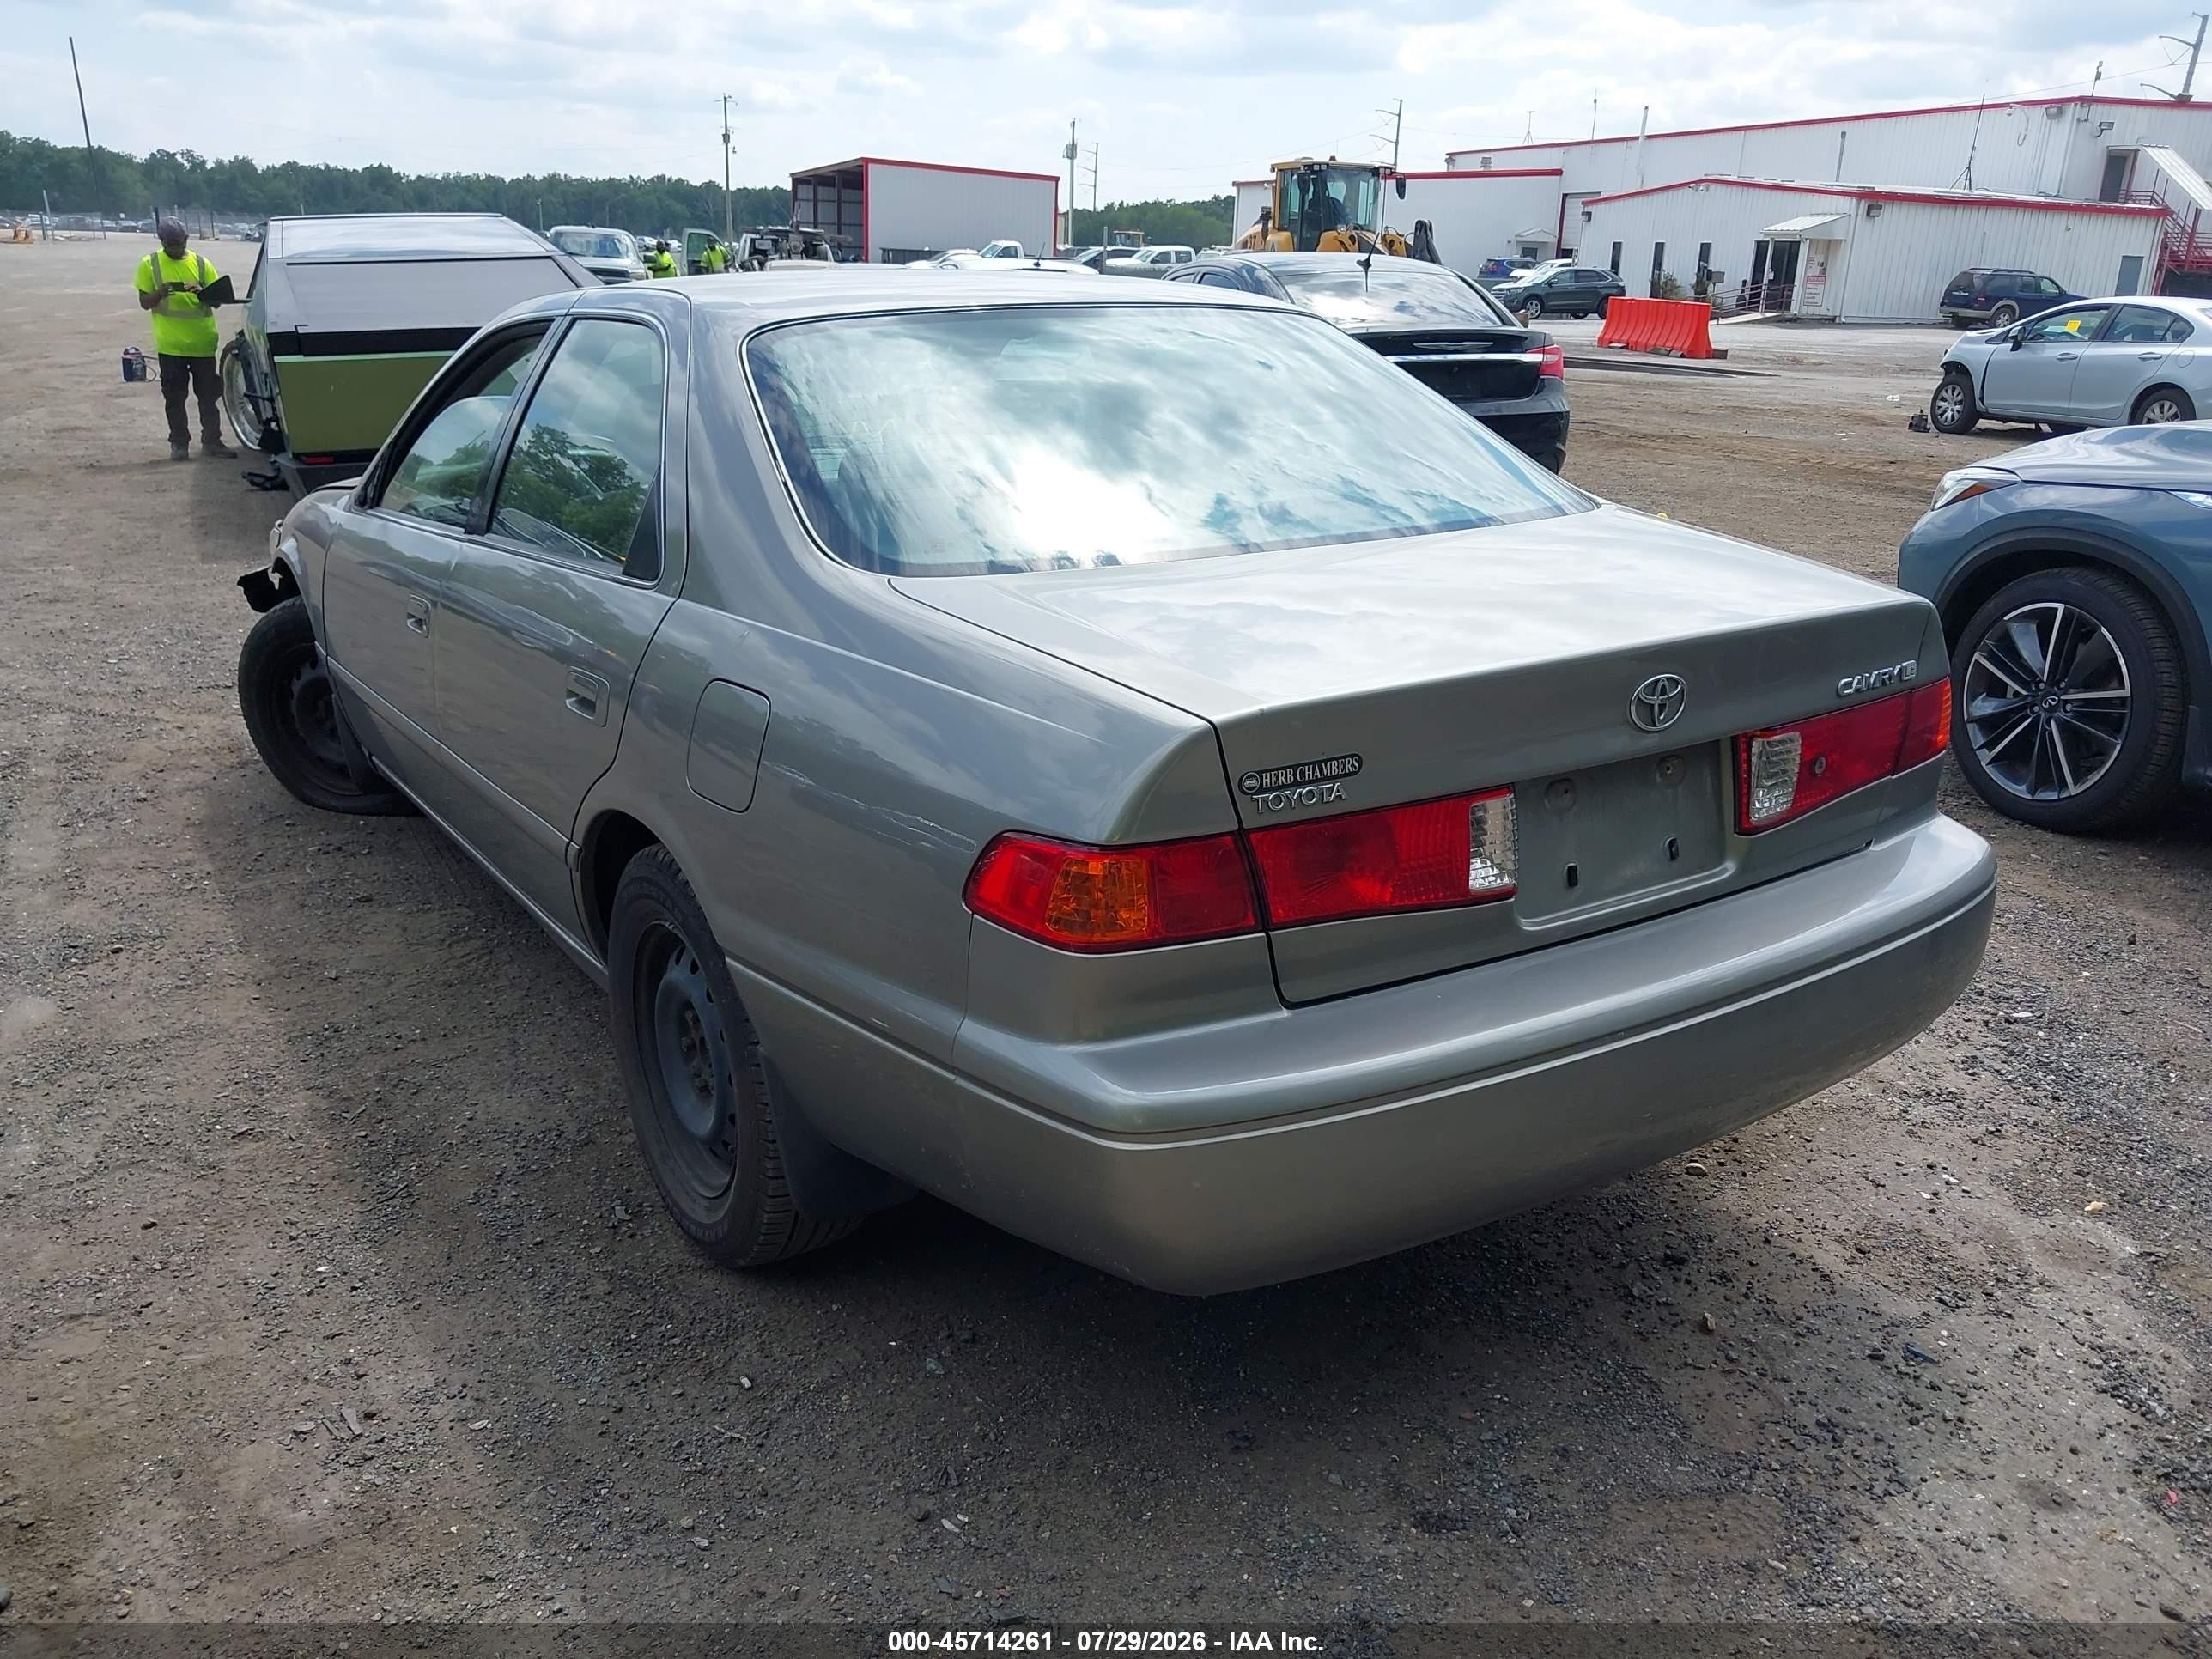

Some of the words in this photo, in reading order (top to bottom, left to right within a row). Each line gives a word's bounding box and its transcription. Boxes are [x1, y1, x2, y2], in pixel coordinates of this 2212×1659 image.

[1837, 665, 1901, 696] CAMRY
[1903, 661, 1917, 678] LE
[1261, 769, 1294, 788] HERB
[1297, 756, 1359, 782] CHAMBERS
[1251, 782, 1347, 813] TOYOTA
